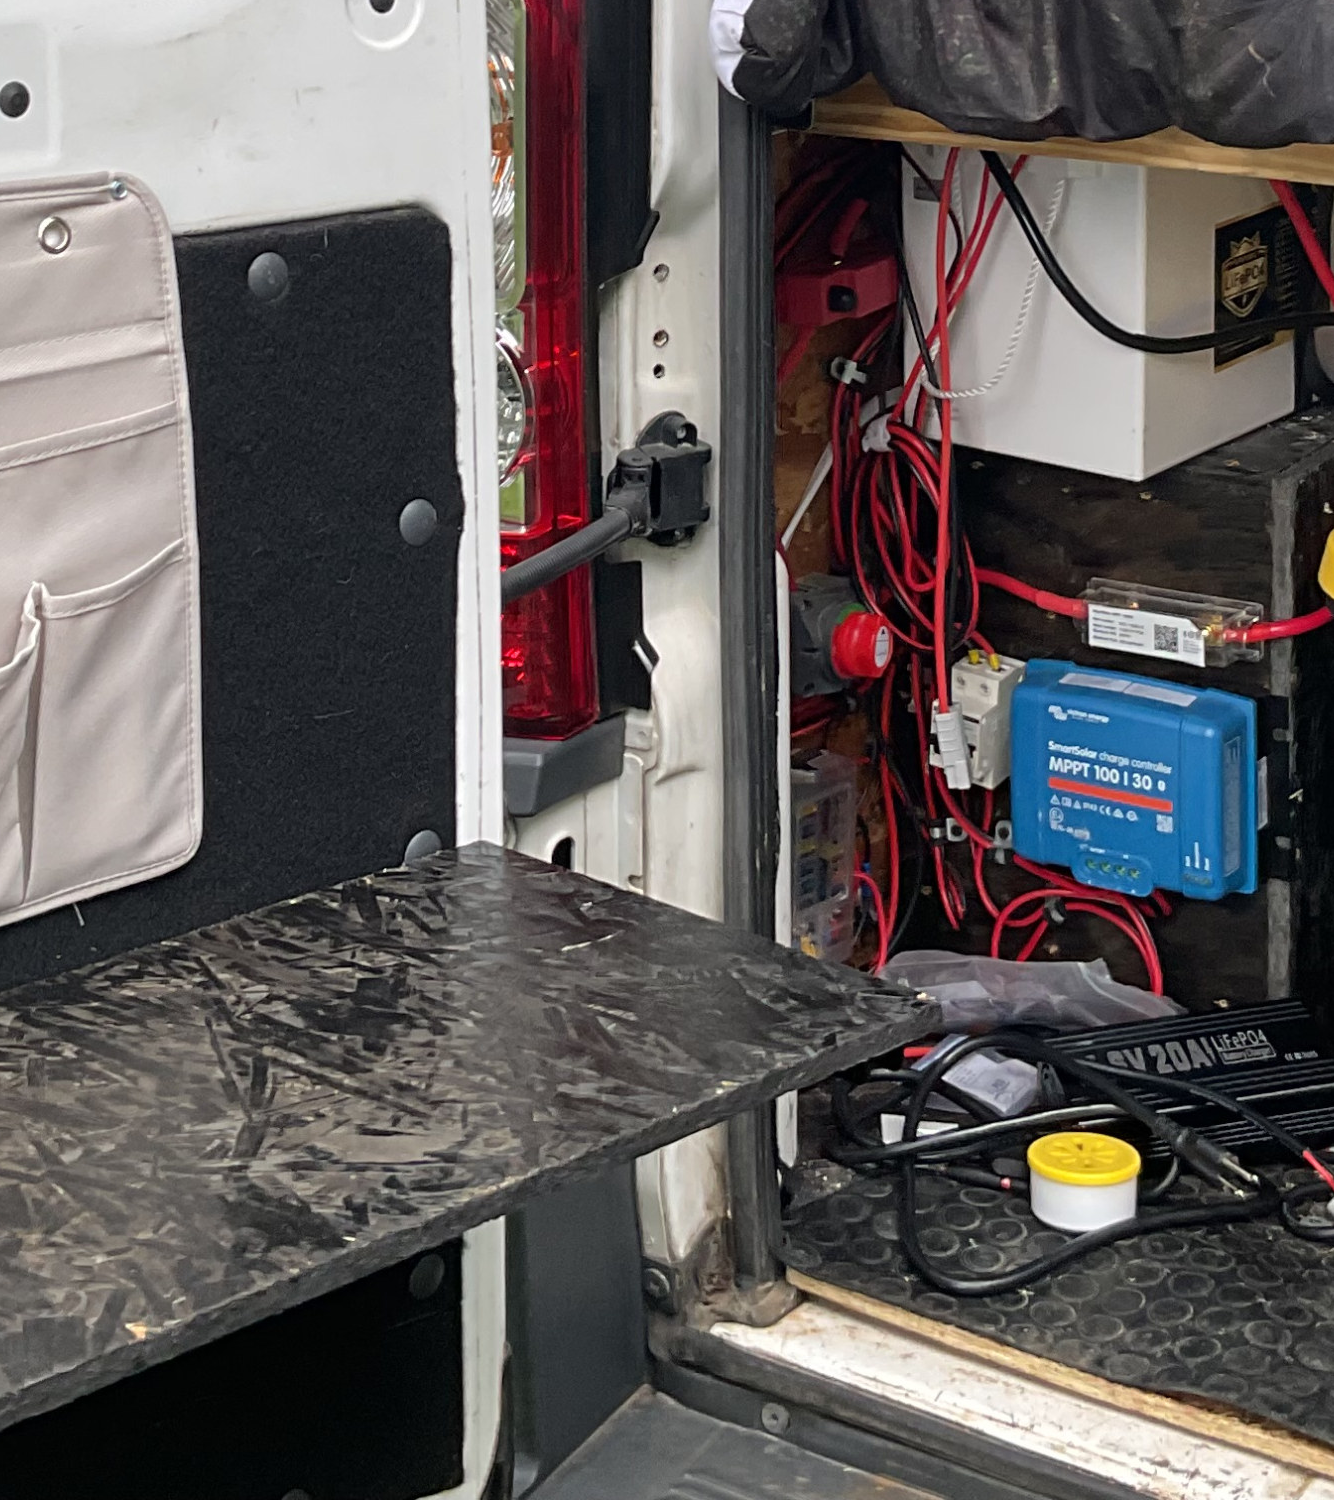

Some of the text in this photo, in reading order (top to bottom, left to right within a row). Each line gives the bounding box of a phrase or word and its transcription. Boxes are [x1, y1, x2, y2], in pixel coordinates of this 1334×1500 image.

[1048, 740, 1173, 775] SmartSolar charge controller
[1048, 755, 1089, 778] MPPT
[1093, 764, 1120, 784] 100
[1132, 773, 1152, 790] 30
[1210, 1029, 1267, 1050] LiFePO4
